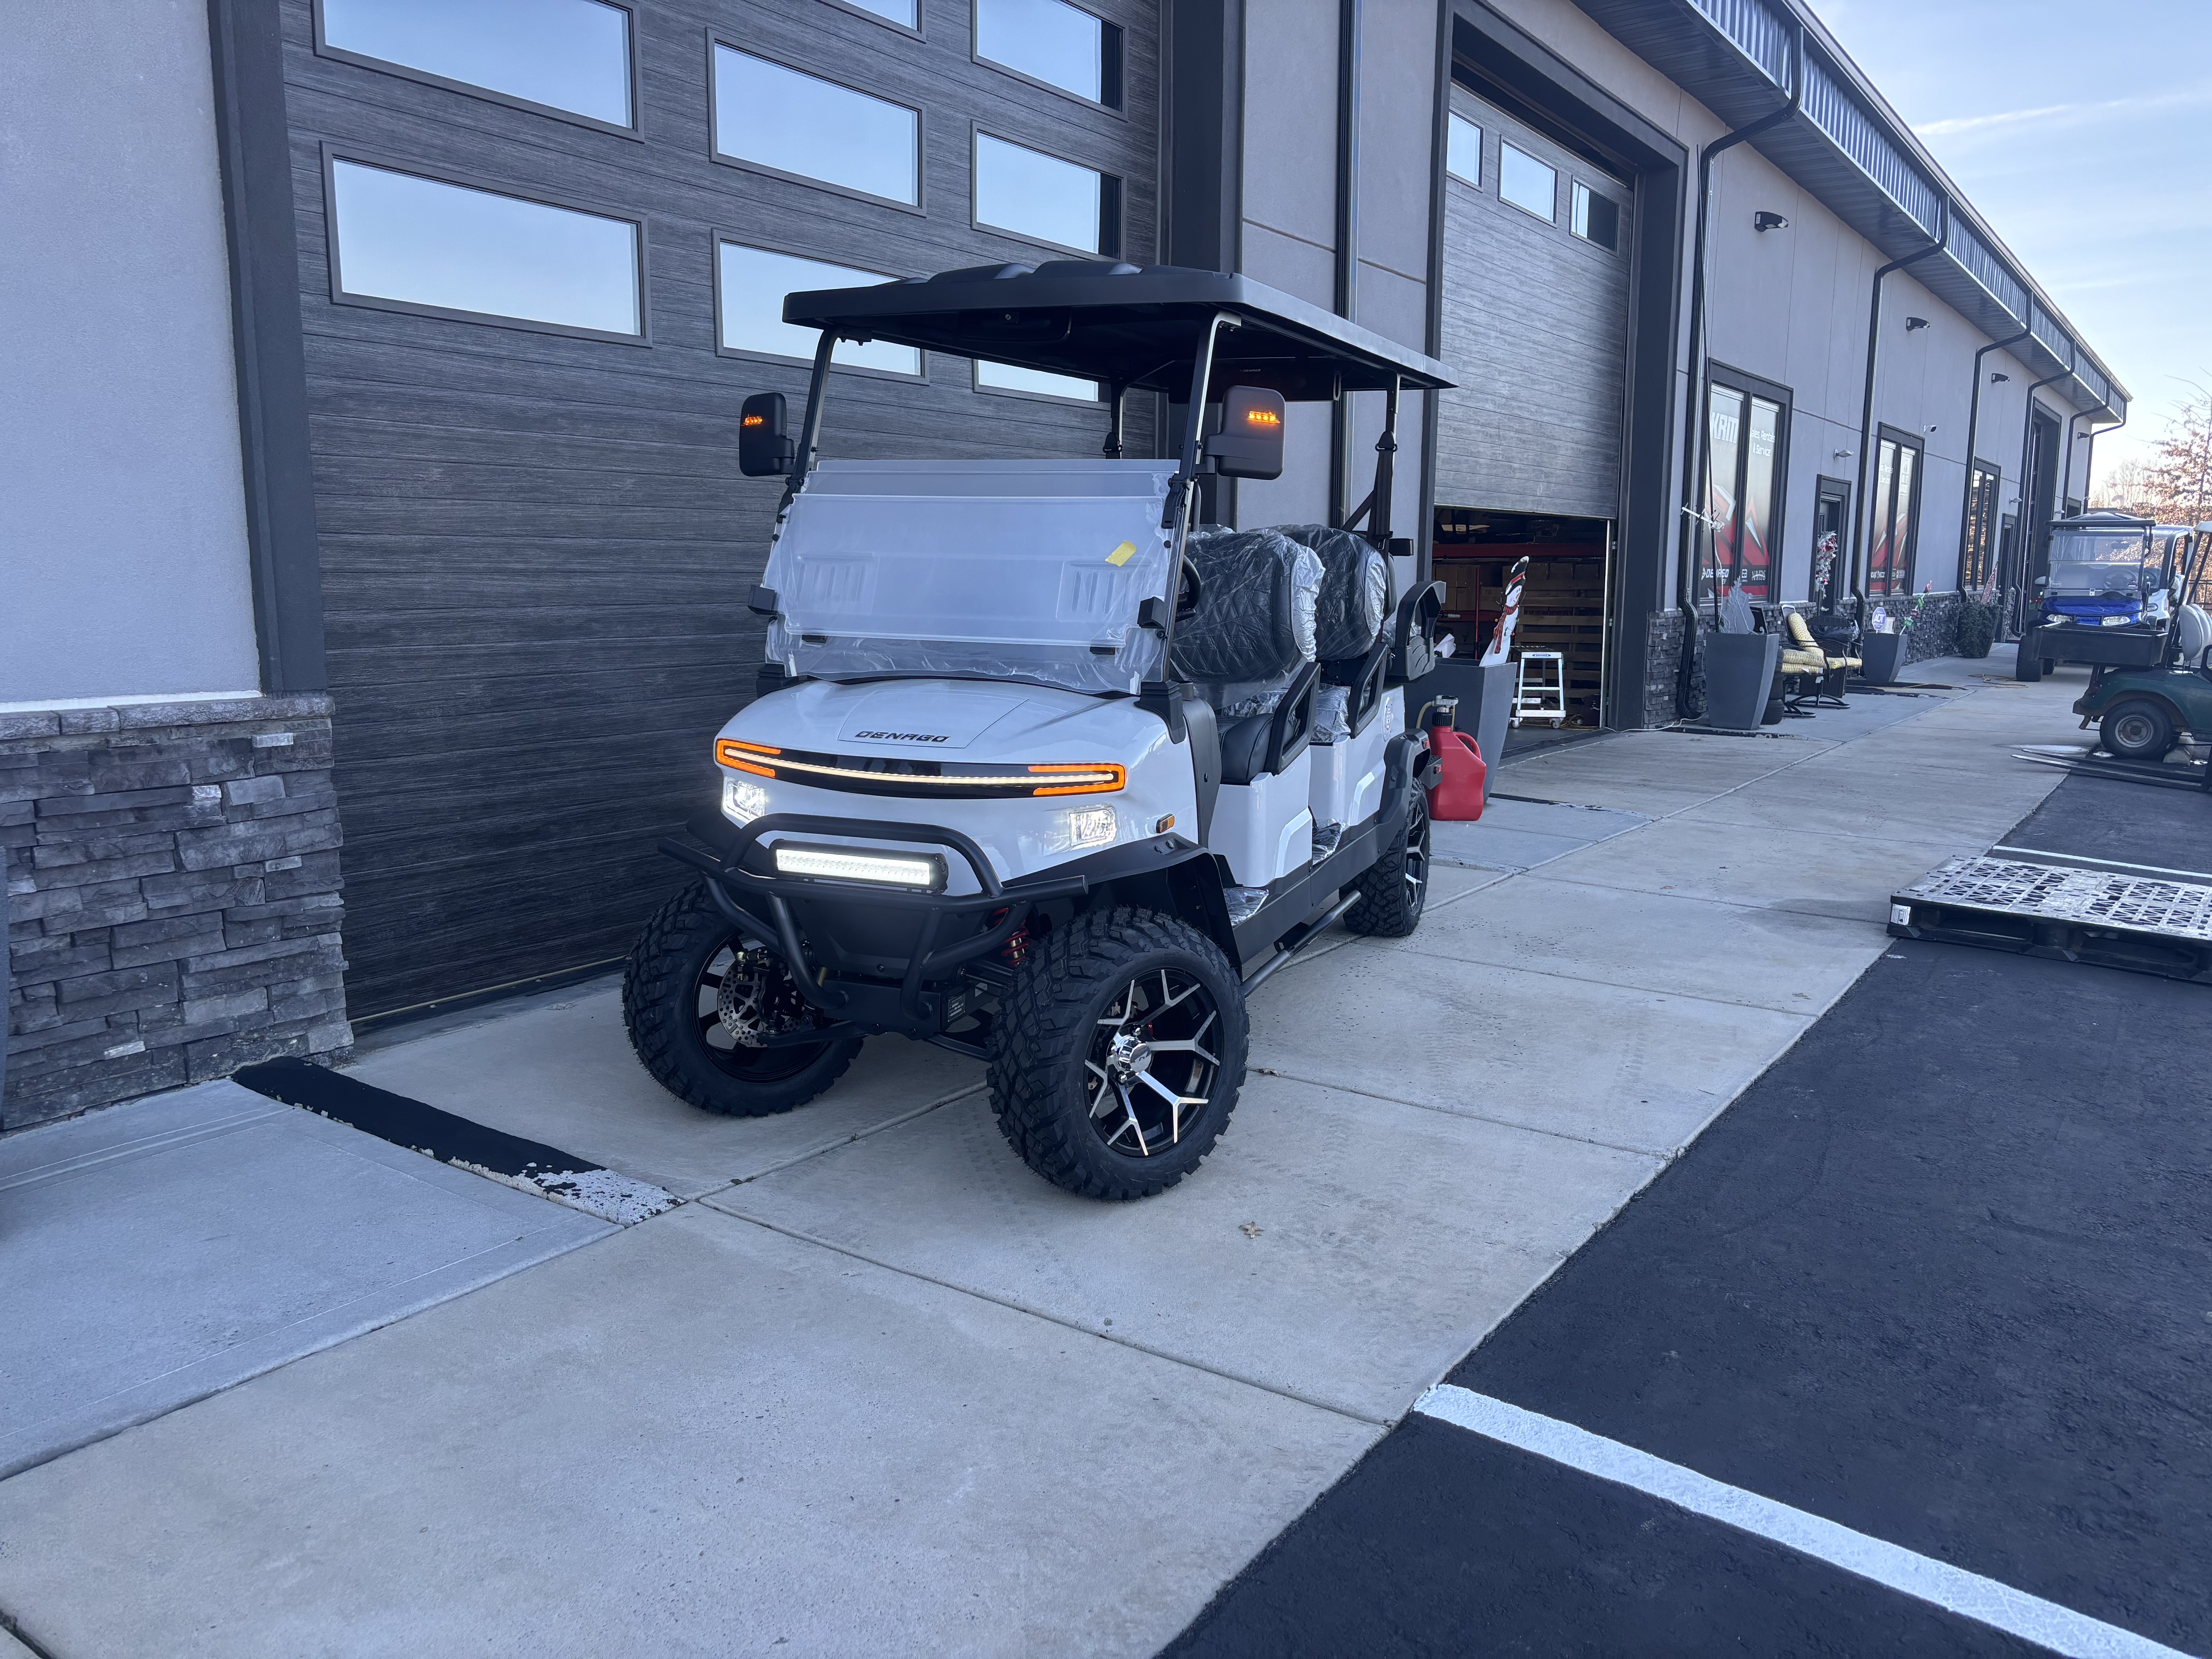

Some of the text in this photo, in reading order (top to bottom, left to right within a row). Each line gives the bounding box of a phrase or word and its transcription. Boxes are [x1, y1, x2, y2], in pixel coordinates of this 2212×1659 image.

[1761, 430, 1775, 443] Rentals
[1756, 444, 1771, 457] Service
[1873, 613, 1885, 623] ADT
[855, 731, 951, 743] DENAGO
